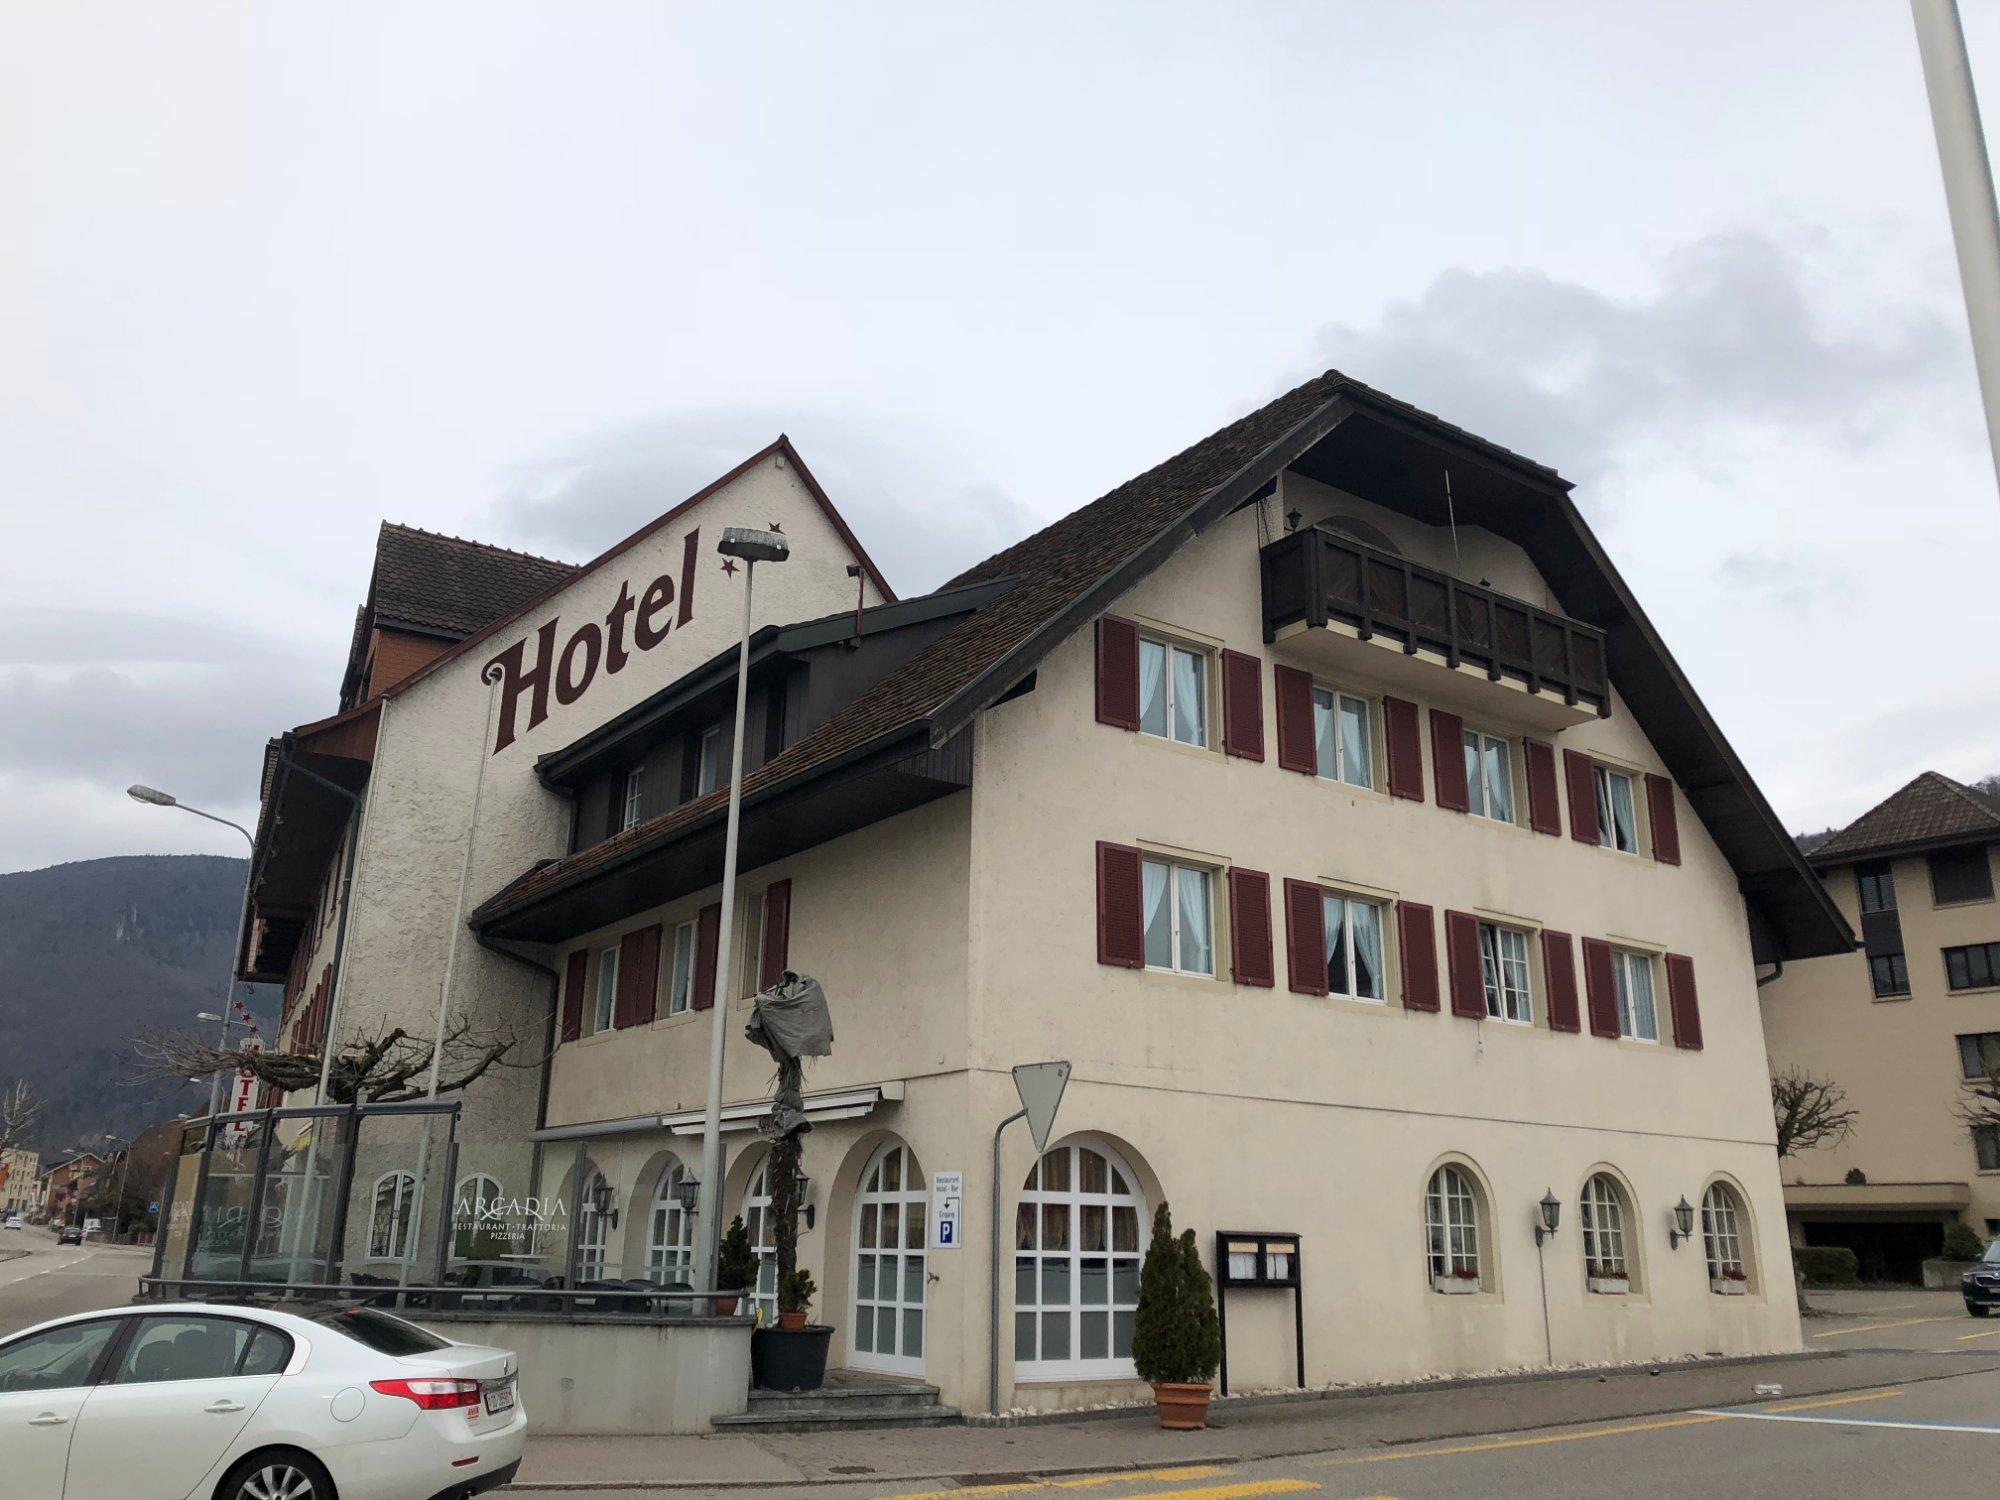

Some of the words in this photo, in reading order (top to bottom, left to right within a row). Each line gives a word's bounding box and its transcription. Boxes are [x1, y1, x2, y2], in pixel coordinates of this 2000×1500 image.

[480, 526, 700, 756] Hotel
[456, 1197, 567, 1221] ARCADIA
[453, 1223, 510, 1231] RESTAURANT
[516, 1223, 567, 1231] TRATTORIA
[490, 1232, 526, 1240] PIZZERIA
[942, 1222, 950, 1241] P
